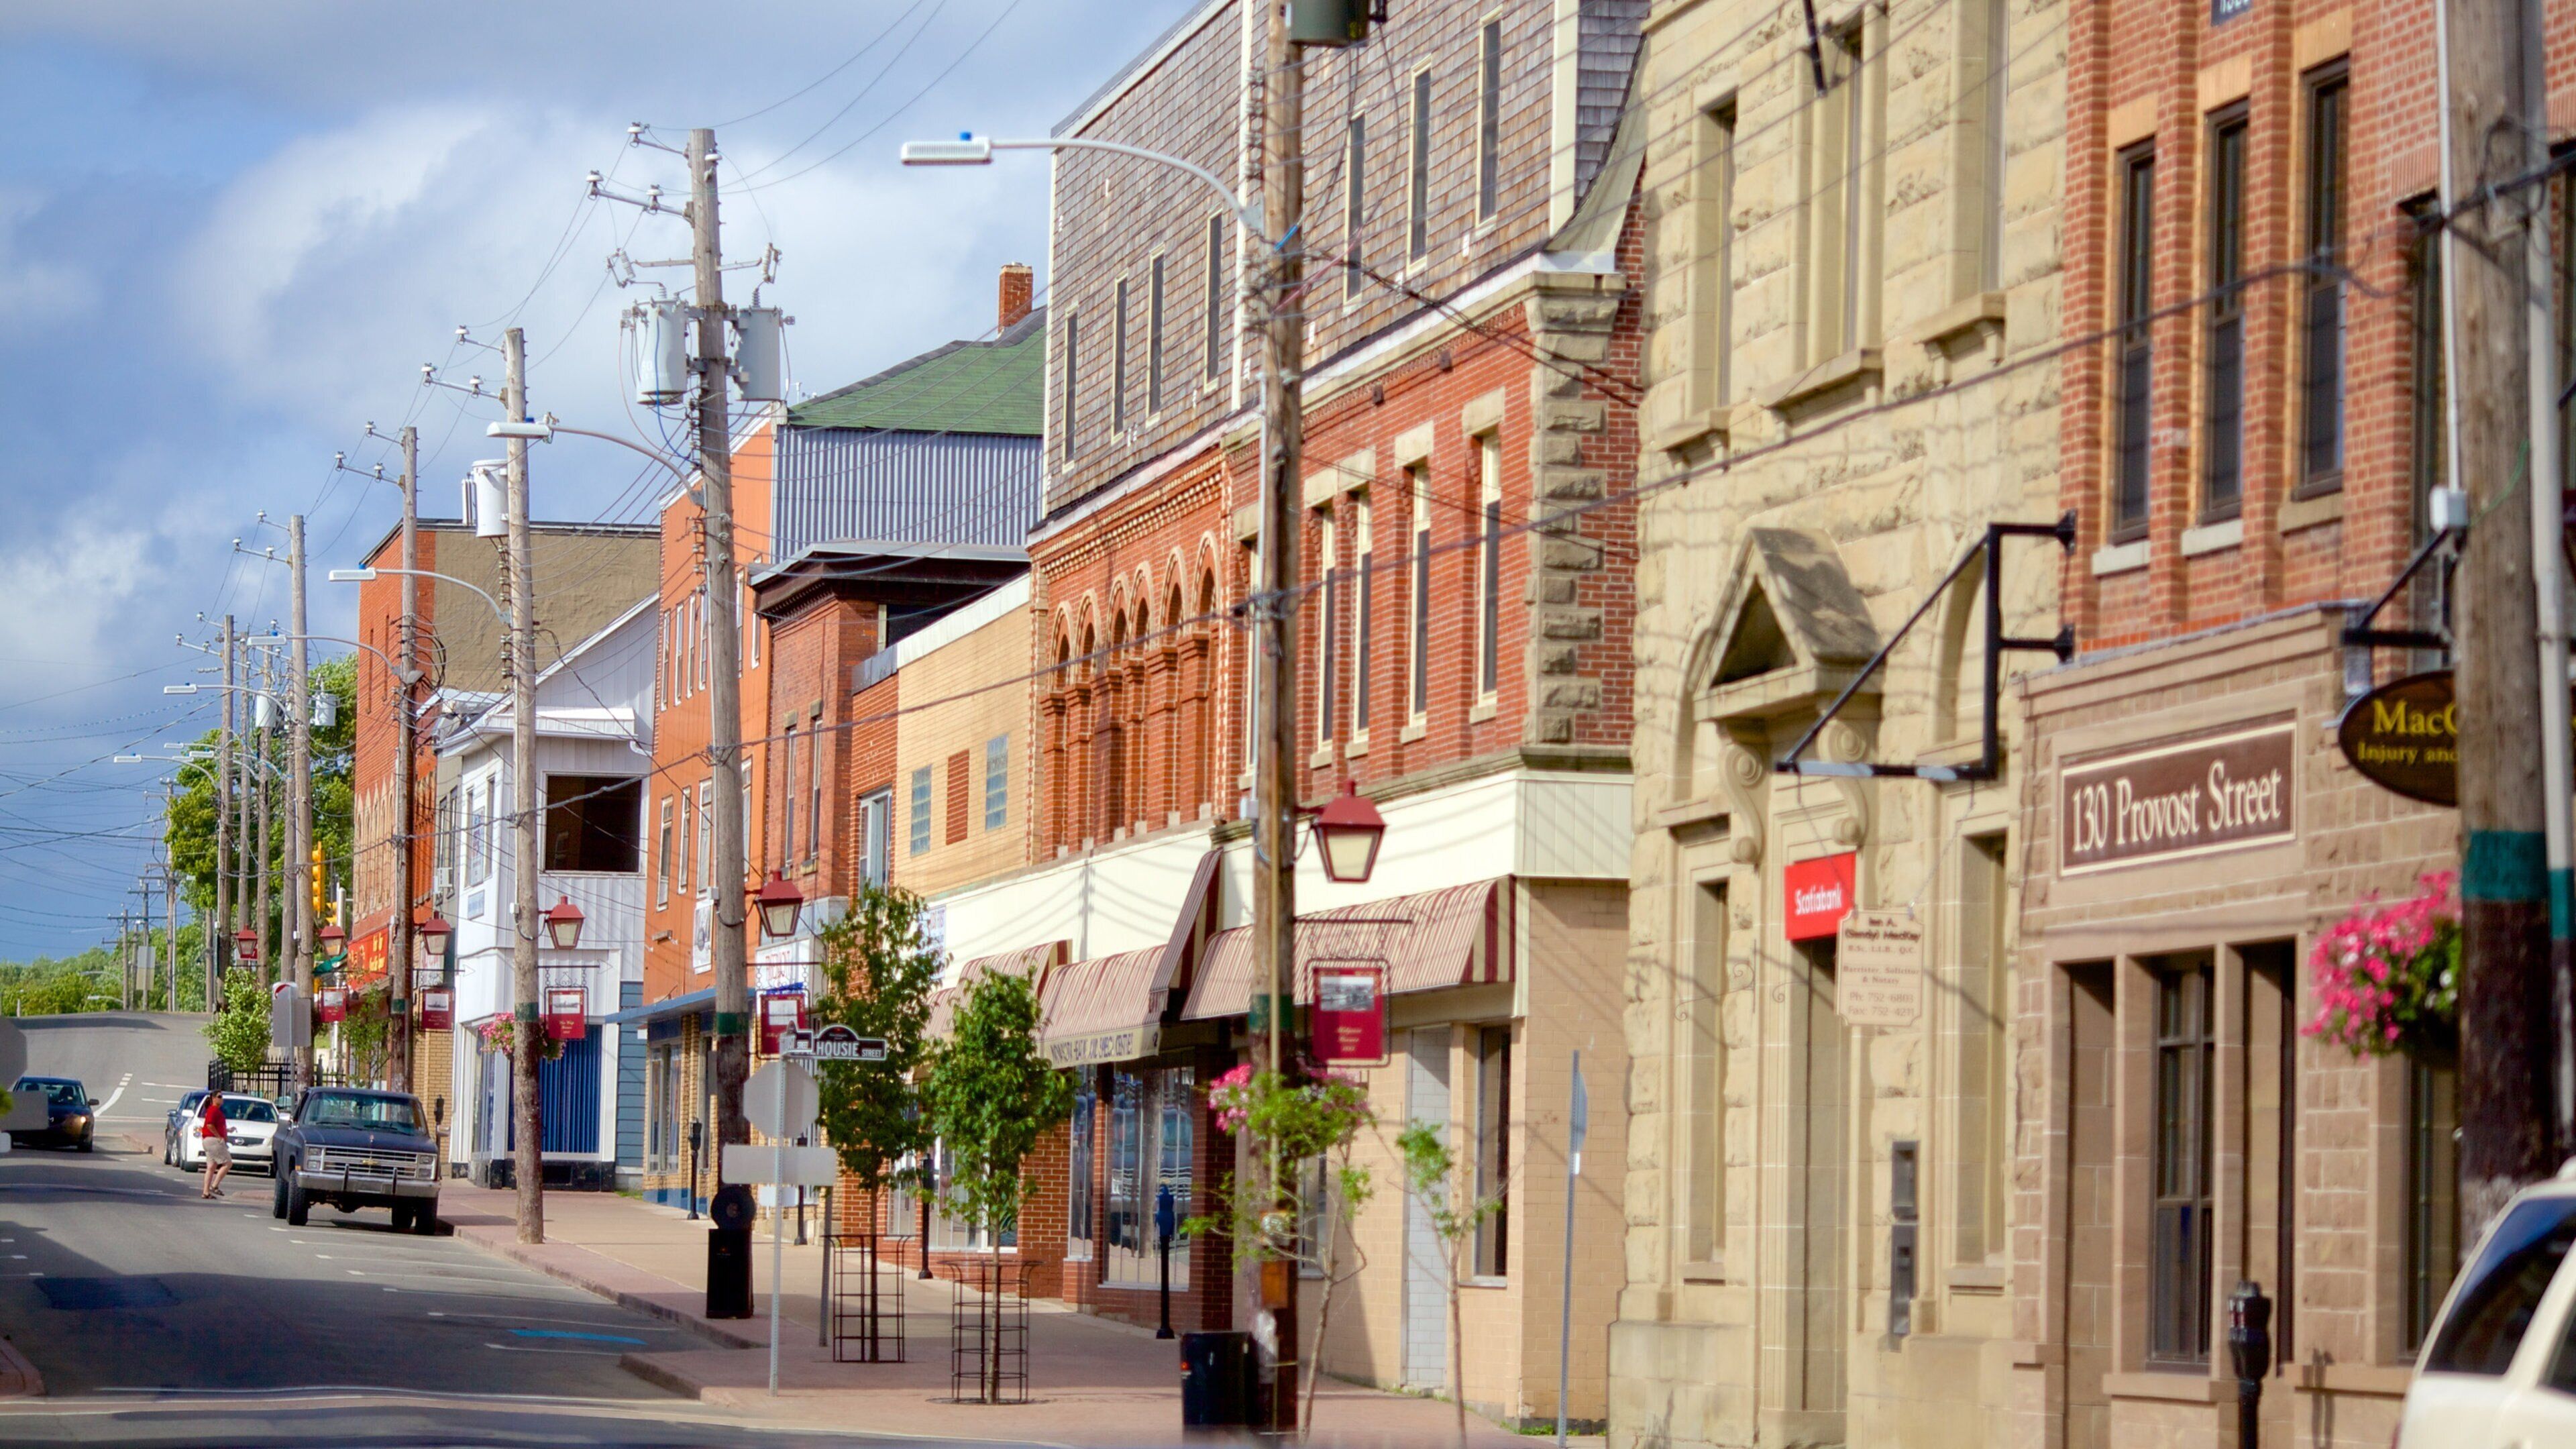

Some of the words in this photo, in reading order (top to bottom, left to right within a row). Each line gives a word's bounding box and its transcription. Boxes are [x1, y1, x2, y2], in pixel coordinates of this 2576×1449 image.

[2357, 742, 2418, 765] Injury
[2072, 782, 2108, 853] 130
[2115, 777, 2200, 846] Provost
[2207, 759, 2282, 832] Street
[1795, 883, 1842, 915] Scotiabank
[1886, 917, 1898, 927] A.
[798, 1040, 860, 1057] HOUSIE
[861, 1049, 882, 1059] STREET
